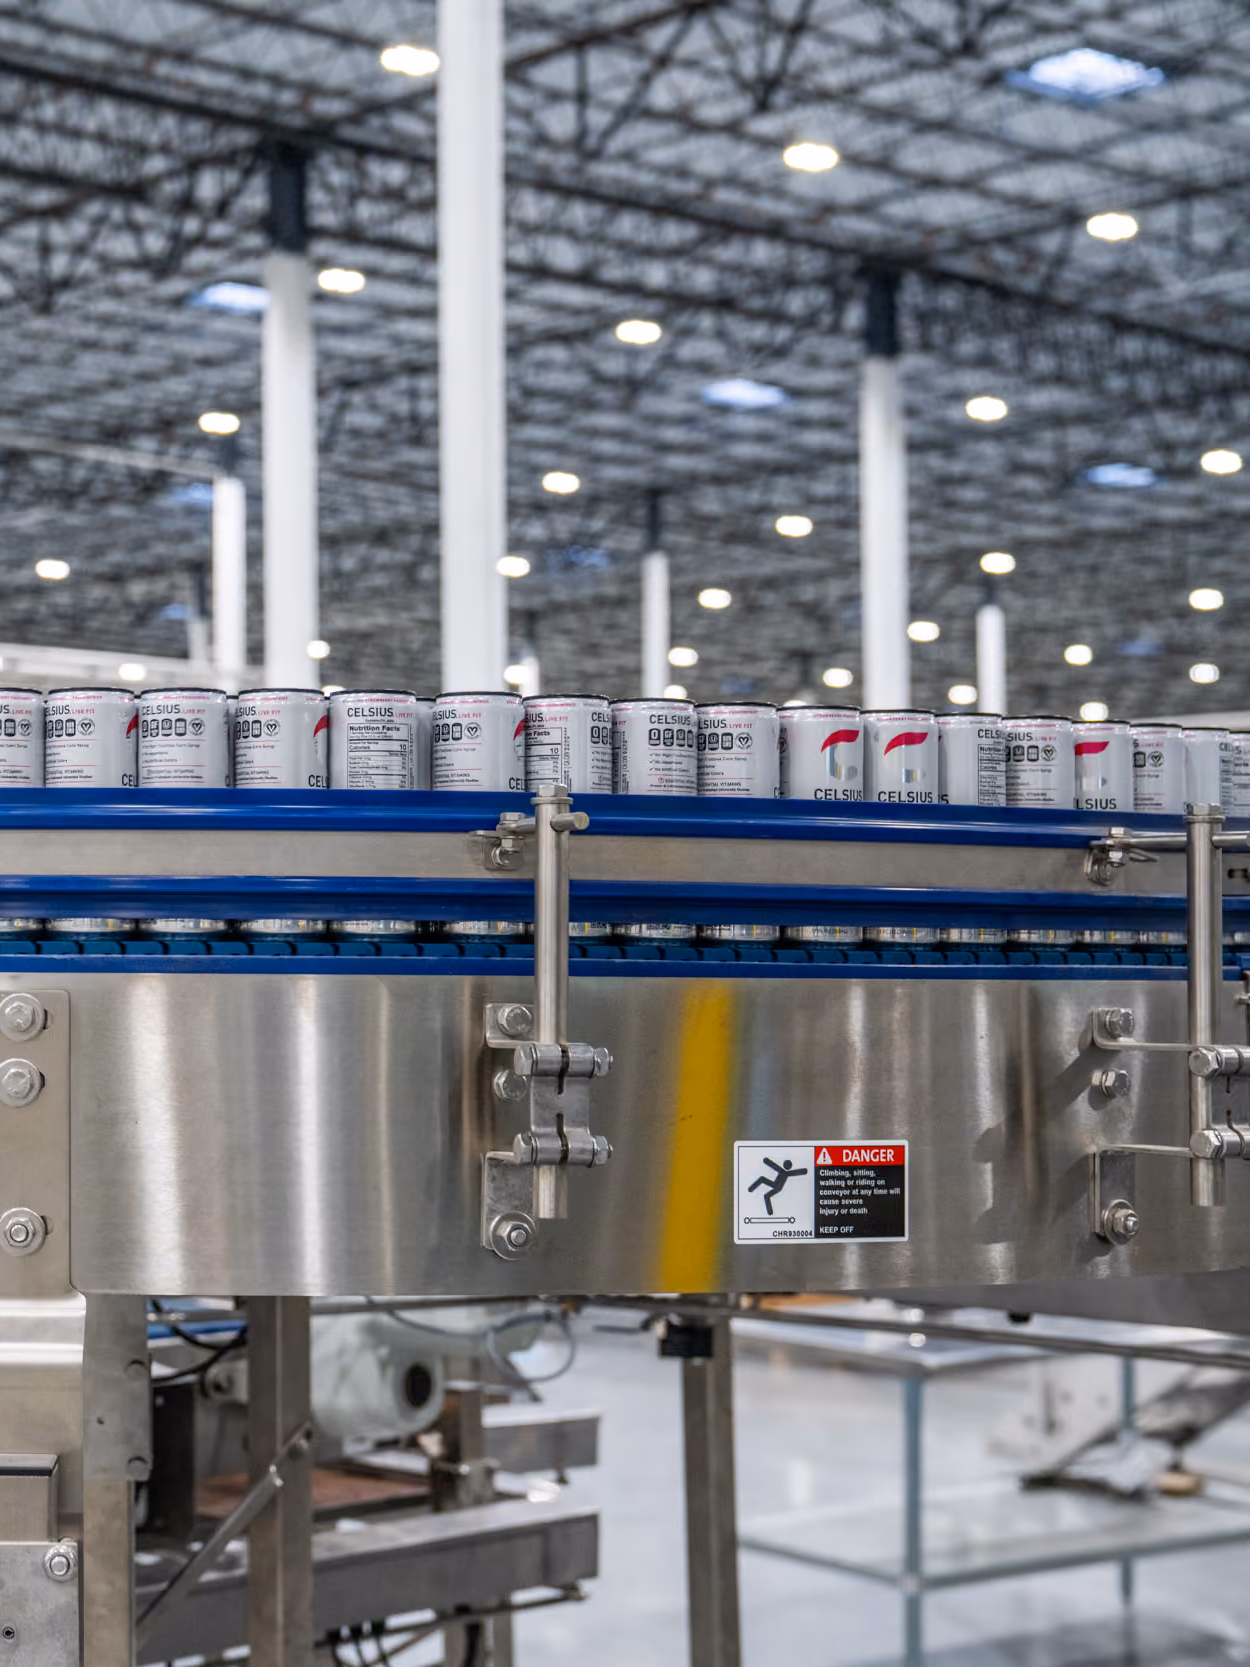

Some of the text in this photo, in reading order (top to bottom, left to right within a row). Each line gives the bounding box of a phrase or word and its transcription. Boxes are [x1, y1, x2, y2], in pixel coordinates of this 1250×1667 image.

[814, 788, 862, 801] CELSIUS
[878, 791, 933, 803] CELSIUS
[842, 1149, 894, 1162] DANGER
[820, 1169, 876, 1177] Climbing, sitting,
[820, 1179, 845, 1187] walking
